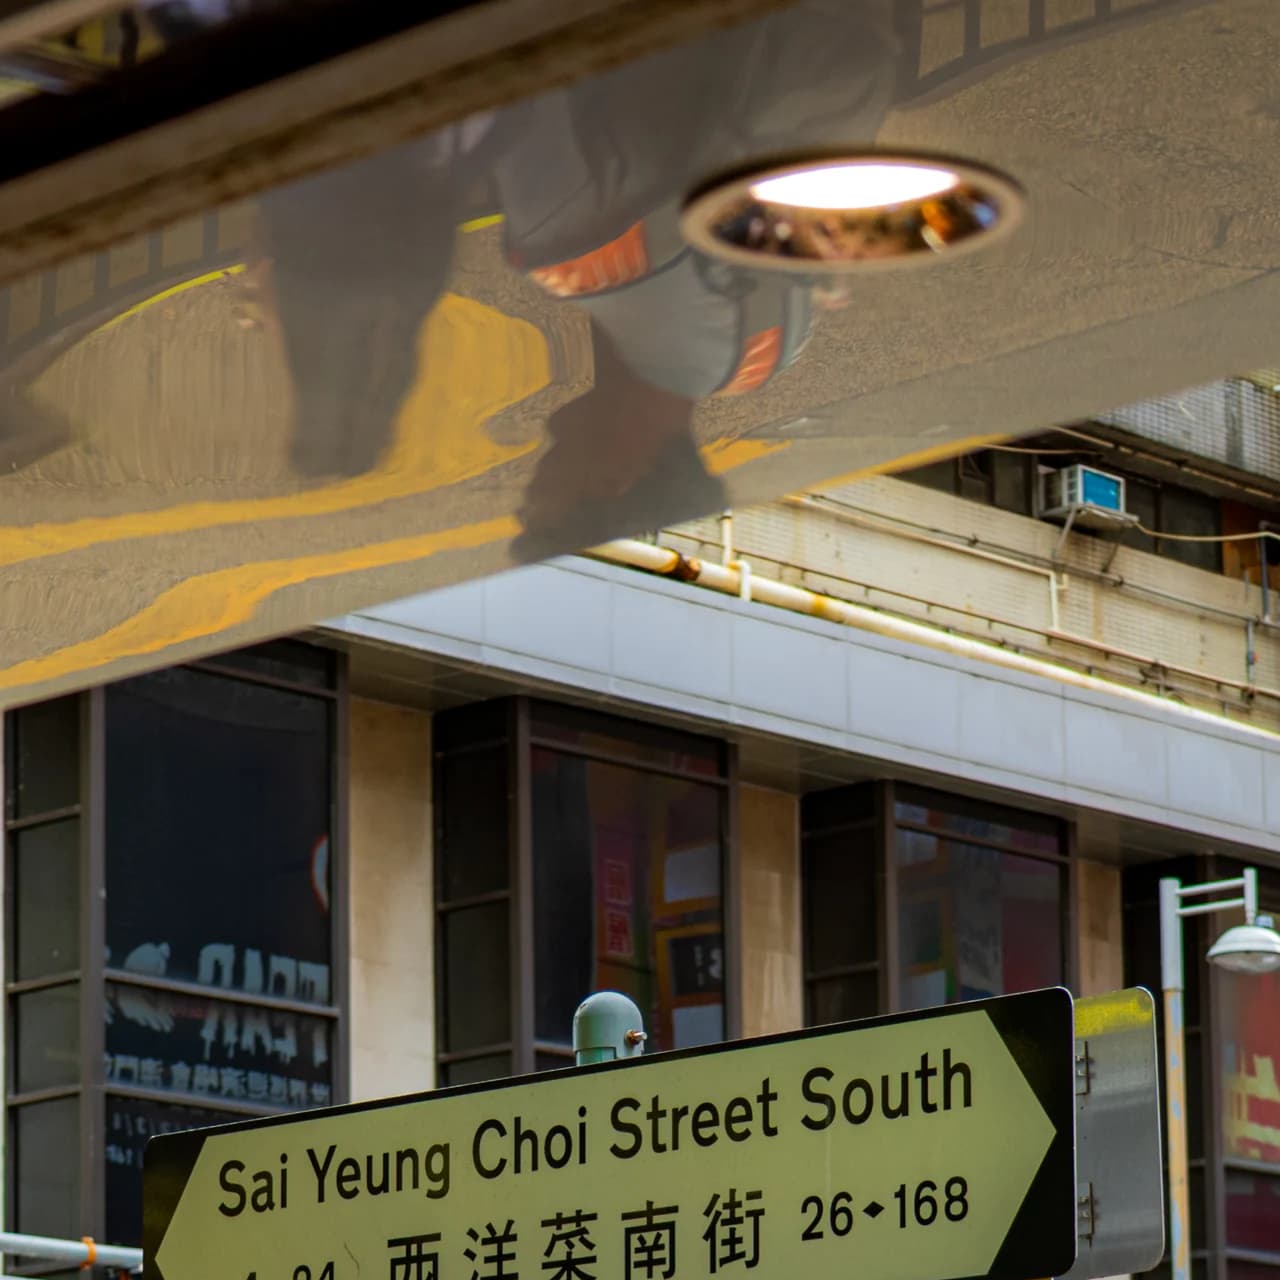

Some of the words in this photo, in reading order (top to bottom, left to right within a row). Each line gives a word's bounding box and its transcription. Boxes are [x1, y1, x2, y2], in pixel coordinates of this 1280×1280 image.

[218, 1154, 289, 1218] Sai
[307, 1143, 451, 1204] Yeung
[473, 1105, 587, 1180] Choi
[609, 1078, 779, 1160] Street
[800, 1046, 972, 1131] South
